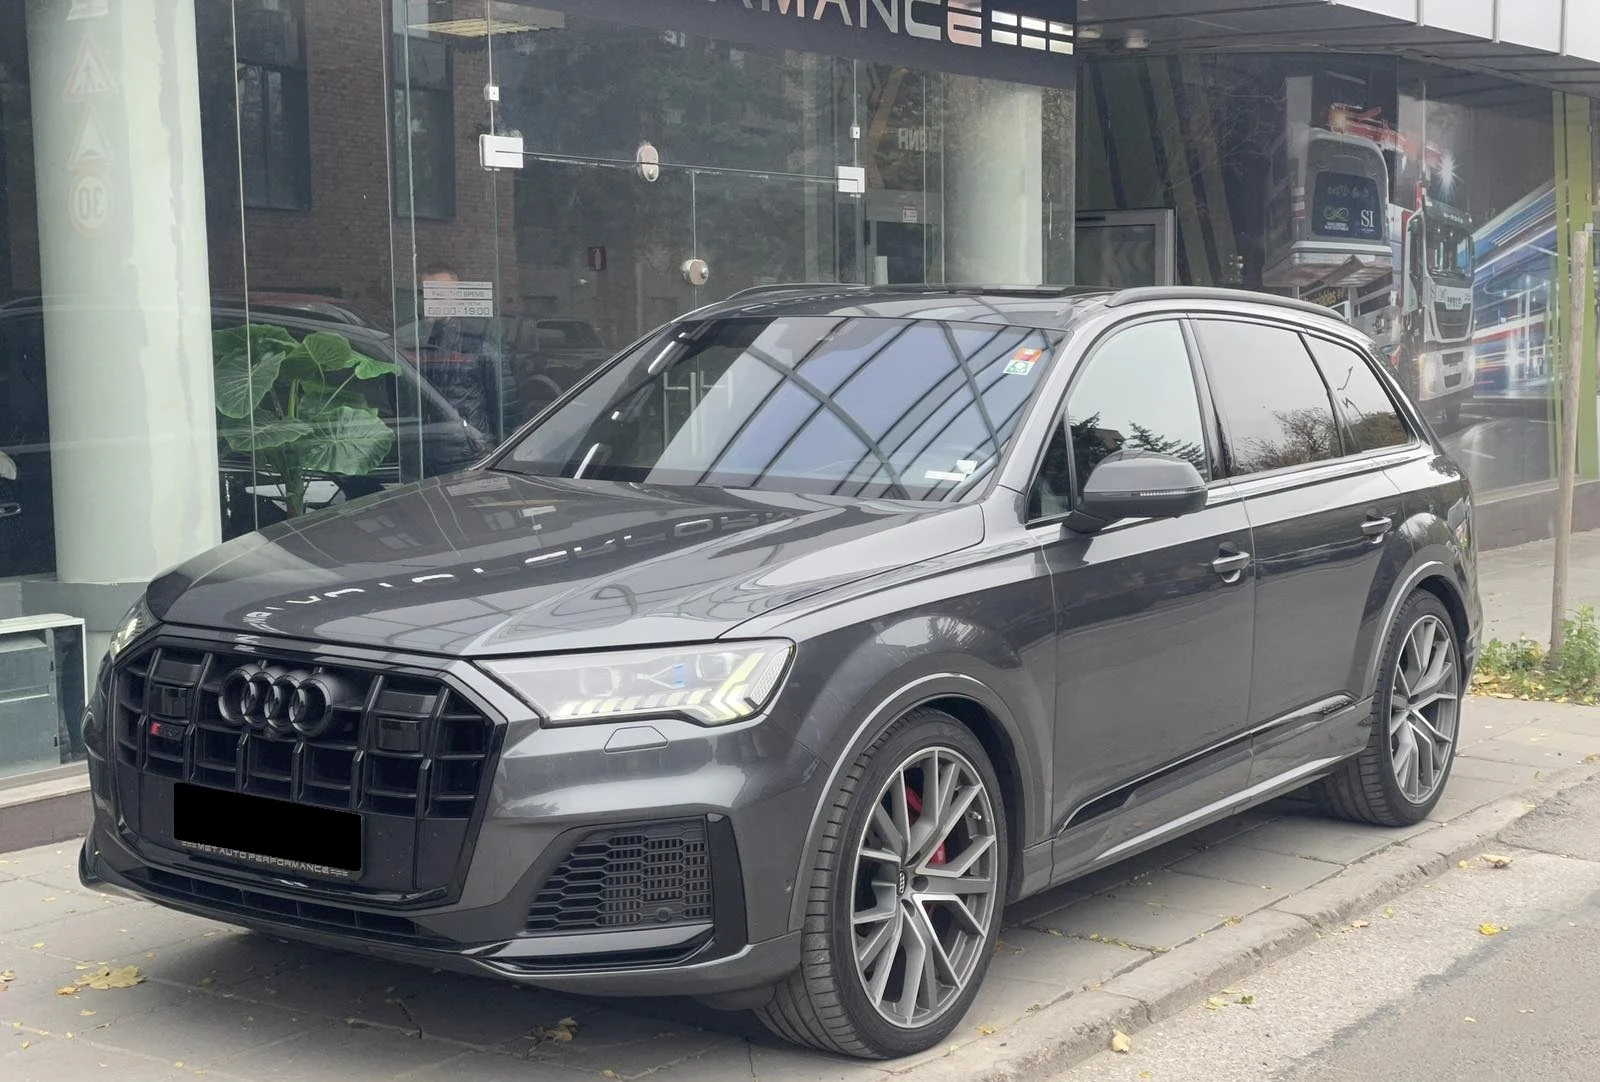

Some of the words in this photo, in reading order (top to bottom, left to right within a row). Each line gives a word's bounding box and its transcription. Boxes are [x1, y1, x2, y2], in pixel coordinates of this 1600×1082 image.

[708, 0, 983, 48] ANCE
[1360, 209, 1376, 228] SI
[219, 847, 247, 860] AUTO
[248, 854, 330, 875] PERFORMANCE
